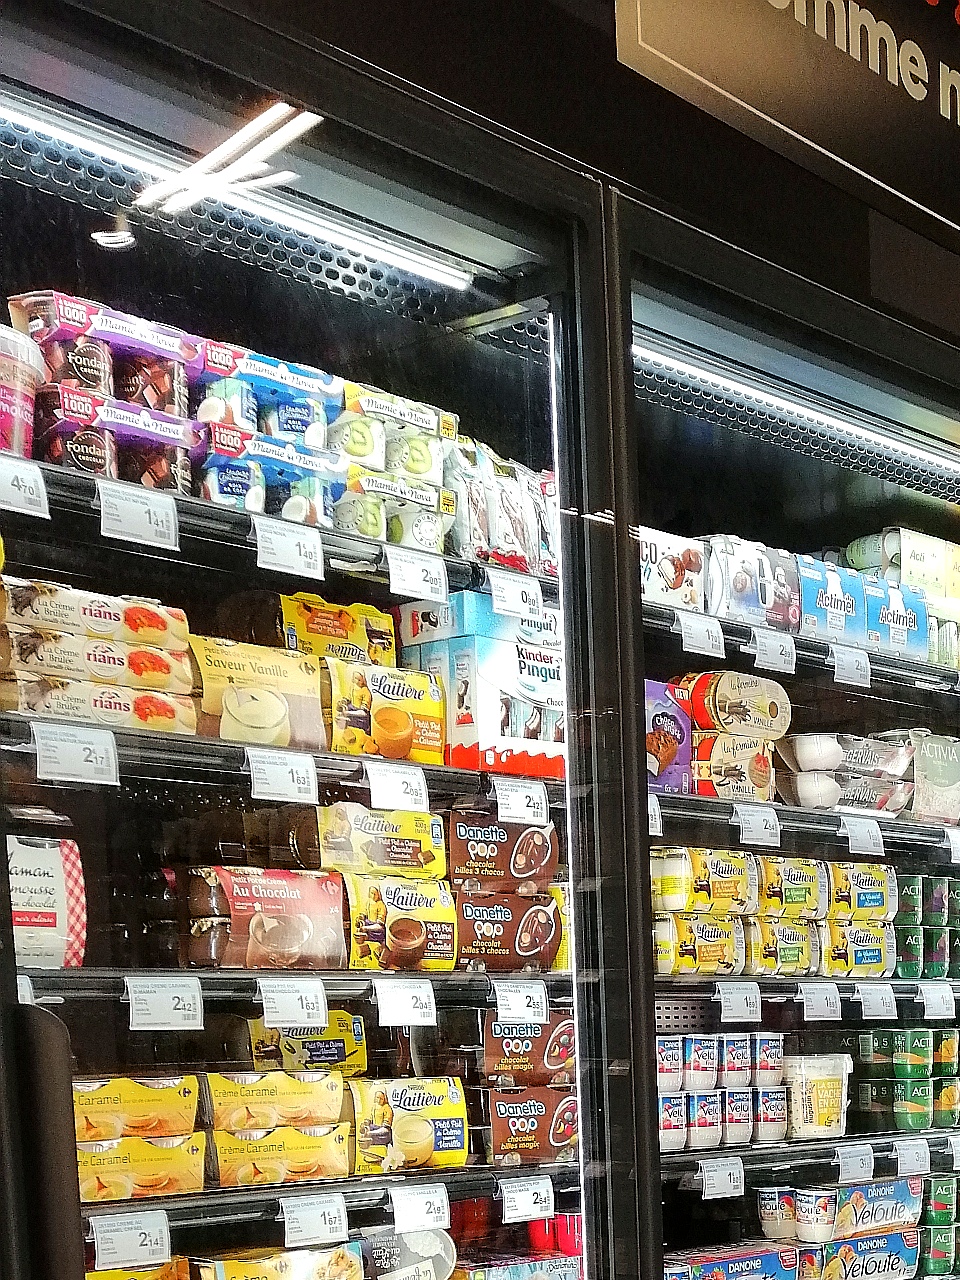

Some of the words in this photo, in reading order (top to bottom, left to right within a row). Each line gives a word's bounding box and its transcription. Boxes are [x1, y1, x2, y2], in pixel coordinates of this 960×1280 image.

[99, 316, 136, 335] Mamie
[151, 331, 177, 348] Nova
[245, 360, 278, 376] Mamie
[291, 374, 316, 390] Nova
[364, 398, 398, 416] Mamie
[407, 410, 432, 426] Nova
[103, 408, 140, 426] Mamie
[152, 422, 180, 437] Nova
[252, 441, 286, 458] Mamie
[295, 452, 321, 468] Nova
[365, 477, 398, 494] Mamie
[407, 487, 432, 502] Nova
[817, 589, 857, 616] Actimel
[82, 604, 120, 623] rians
[880, 607, 918, 630] Actimel
[86, 651, 124, 667] rians
[516, 645, 554, 664] Kinder
[205, 654, 247, 673] Saveur
[250, 661, 288, 678] Vanille
[518, 660, 561, 682] Pingui
[374, 676, 425, 701] Laitière
[92, 695, 131, 712] rians
[847, 749, 879, 764] GERVAIS
[920, 744, 959, 763] ACTIVIA
[847, 786, 878, 801] GERVAIS
[358, 815, 402, 835] Laitière
[457, 823, 508, 842] Danette
[233, 885, 250, 897] Au
[252, 884, 301, 899] Chocolat
[388, 889, 436, 910] Laitière
[463, 904, 512, 921] Danette
[492, 1023, 542, 1037] Danette
[78, 1093, 122, 1106] Caramel
[214, 1088, 238, 1098] Crème
[239, 1085, 277, 1097] Caramel
[395, 1092, 443, 1111] Laitière
[497, 1100, 546, 1116] Danette
[220, 1145, 245, 1155] Crème
[247, 1142, 286, 1153] Caramel
[90, 1153, 131, 1165] Caramel
[868, 1185, 894, 1199] DANONE
[853, 1199, 905, 1227] Velouté
[858, 1238, 887, 1251] DANONE
[728, 1259, 762, 1274] DANONE
[841, 1250, 900, 1279] Velouté
